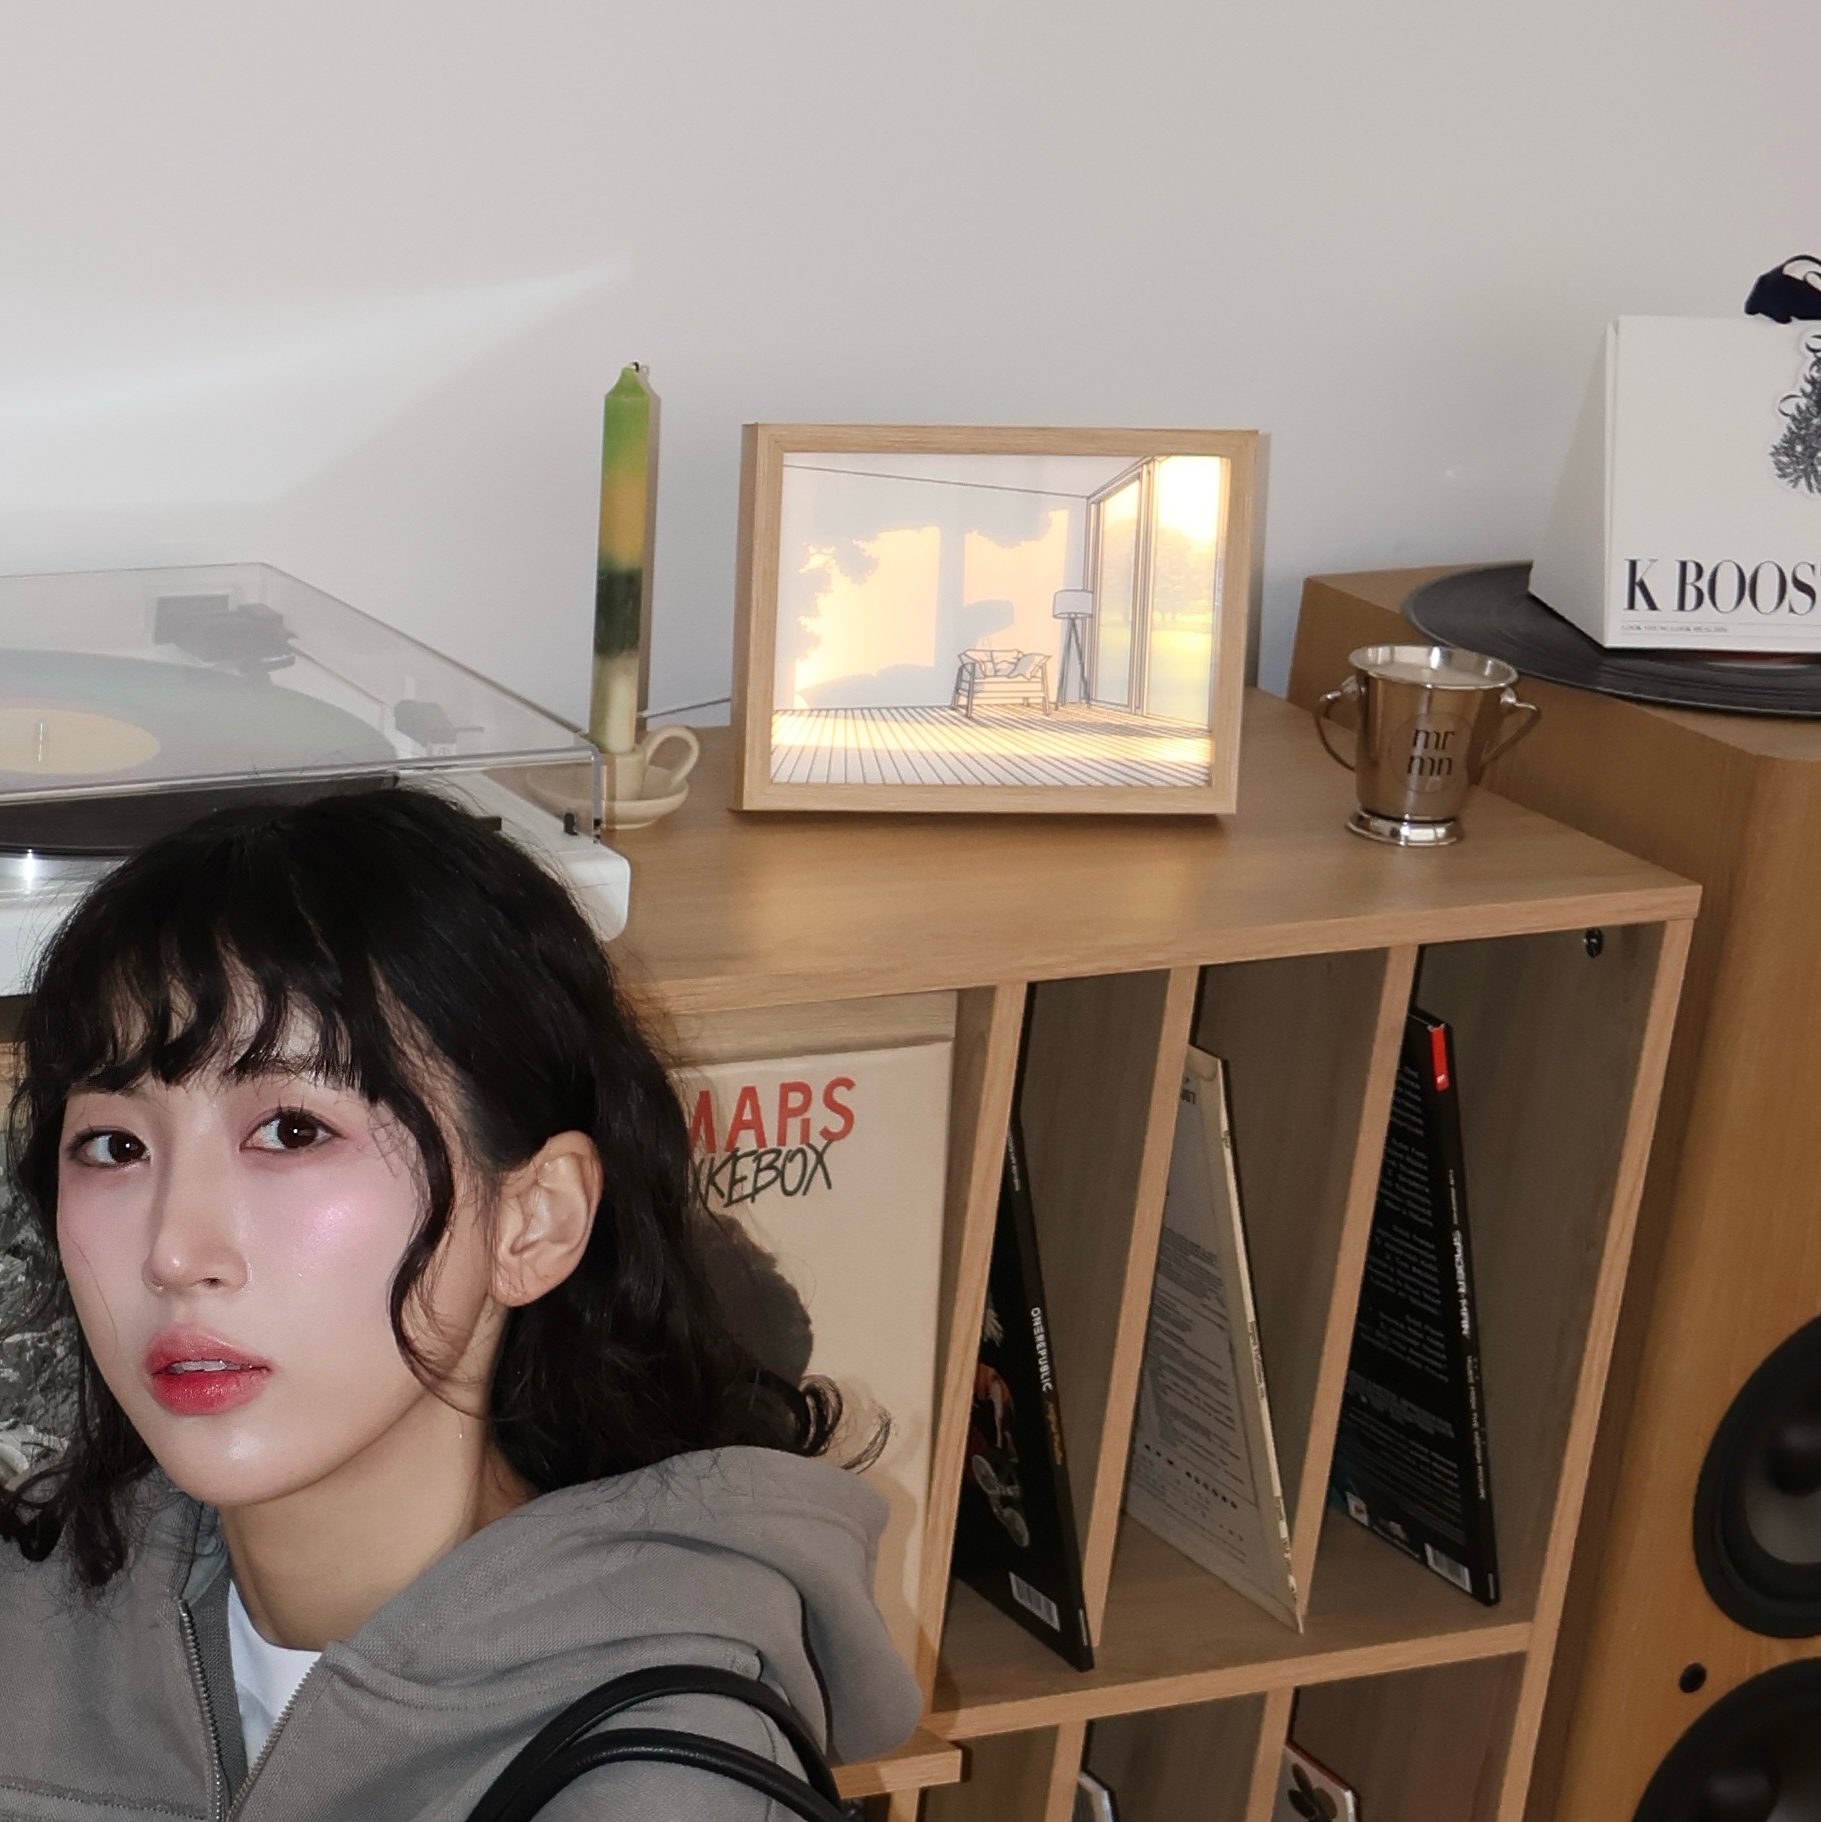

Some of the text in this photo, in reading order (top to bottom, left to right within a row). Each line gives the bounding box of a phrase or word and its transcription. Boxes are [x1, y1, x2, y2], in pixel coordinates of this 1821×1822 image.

[1624, 558, 1821, 616] K BOOS
[1407, 755, 1452, 776] mn
[1413, 729, 1455, 749] mr
[692, 1139, 833, 1208] KEBOX
[1030, 1306, 1053, 1392] ONEREPUBLIC
